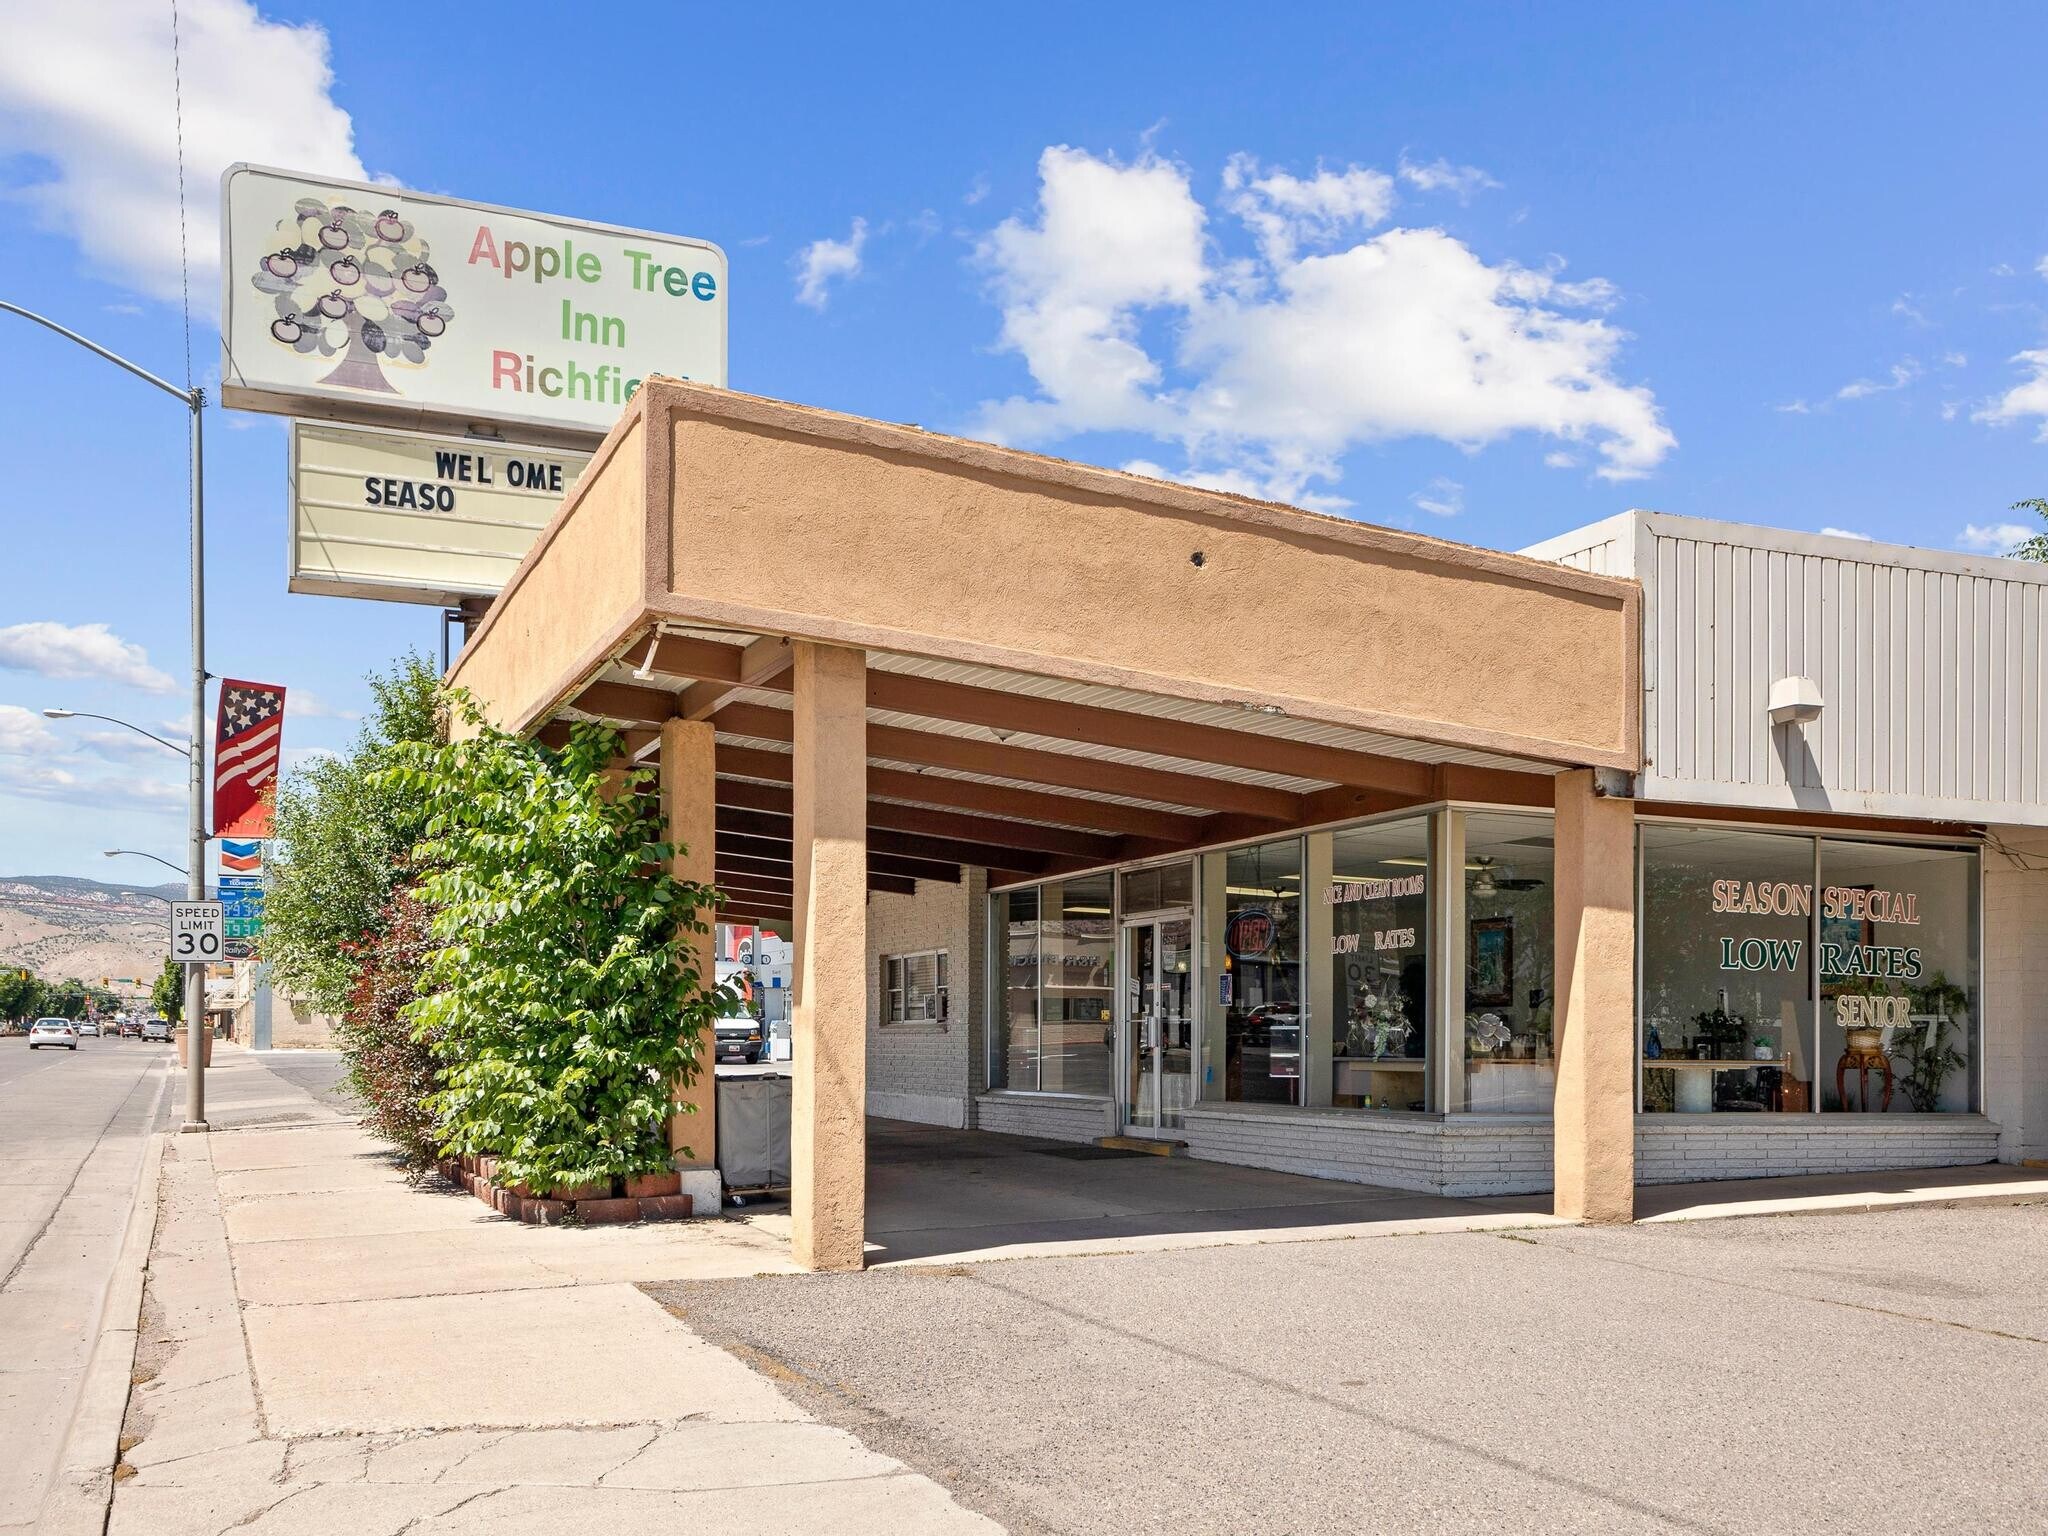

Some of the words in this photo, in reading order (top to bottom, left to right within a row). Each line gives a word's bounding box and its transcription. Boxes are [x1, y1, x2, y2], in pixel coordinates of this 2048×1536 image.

[467, 225, 602, 284] Apple
[623, 248, 717, 302] Tree
[561, 298, 626, 349] Inn
[492, 349, 689, 404] Richfi
[365, 477, 455, 513] SEASO
[1323, 884, 1343, 904] NICE
[1344, 882, 1361, 902] AND
[1363, 880, 1391, 900] CLEAN
[1391, 875, 1424, 897] ROOMS
[1712, 879, 1813, 917] SEASON
[1823, 886, 1921, 925] SPECIAL
[176, 908, 219, 917] SPEED
[180, 920, 215, 930] LIMIT
[176, 932, 219, 955] 30
[1330, 934, 1360, 955] LOW
[1374, 928, 1416, 950] RATES
[1720, 937, 1802, 972] LOW
[1819, 943, 1922, 979] RATES
[1837, 994, 1912, 1028] SENIOR
